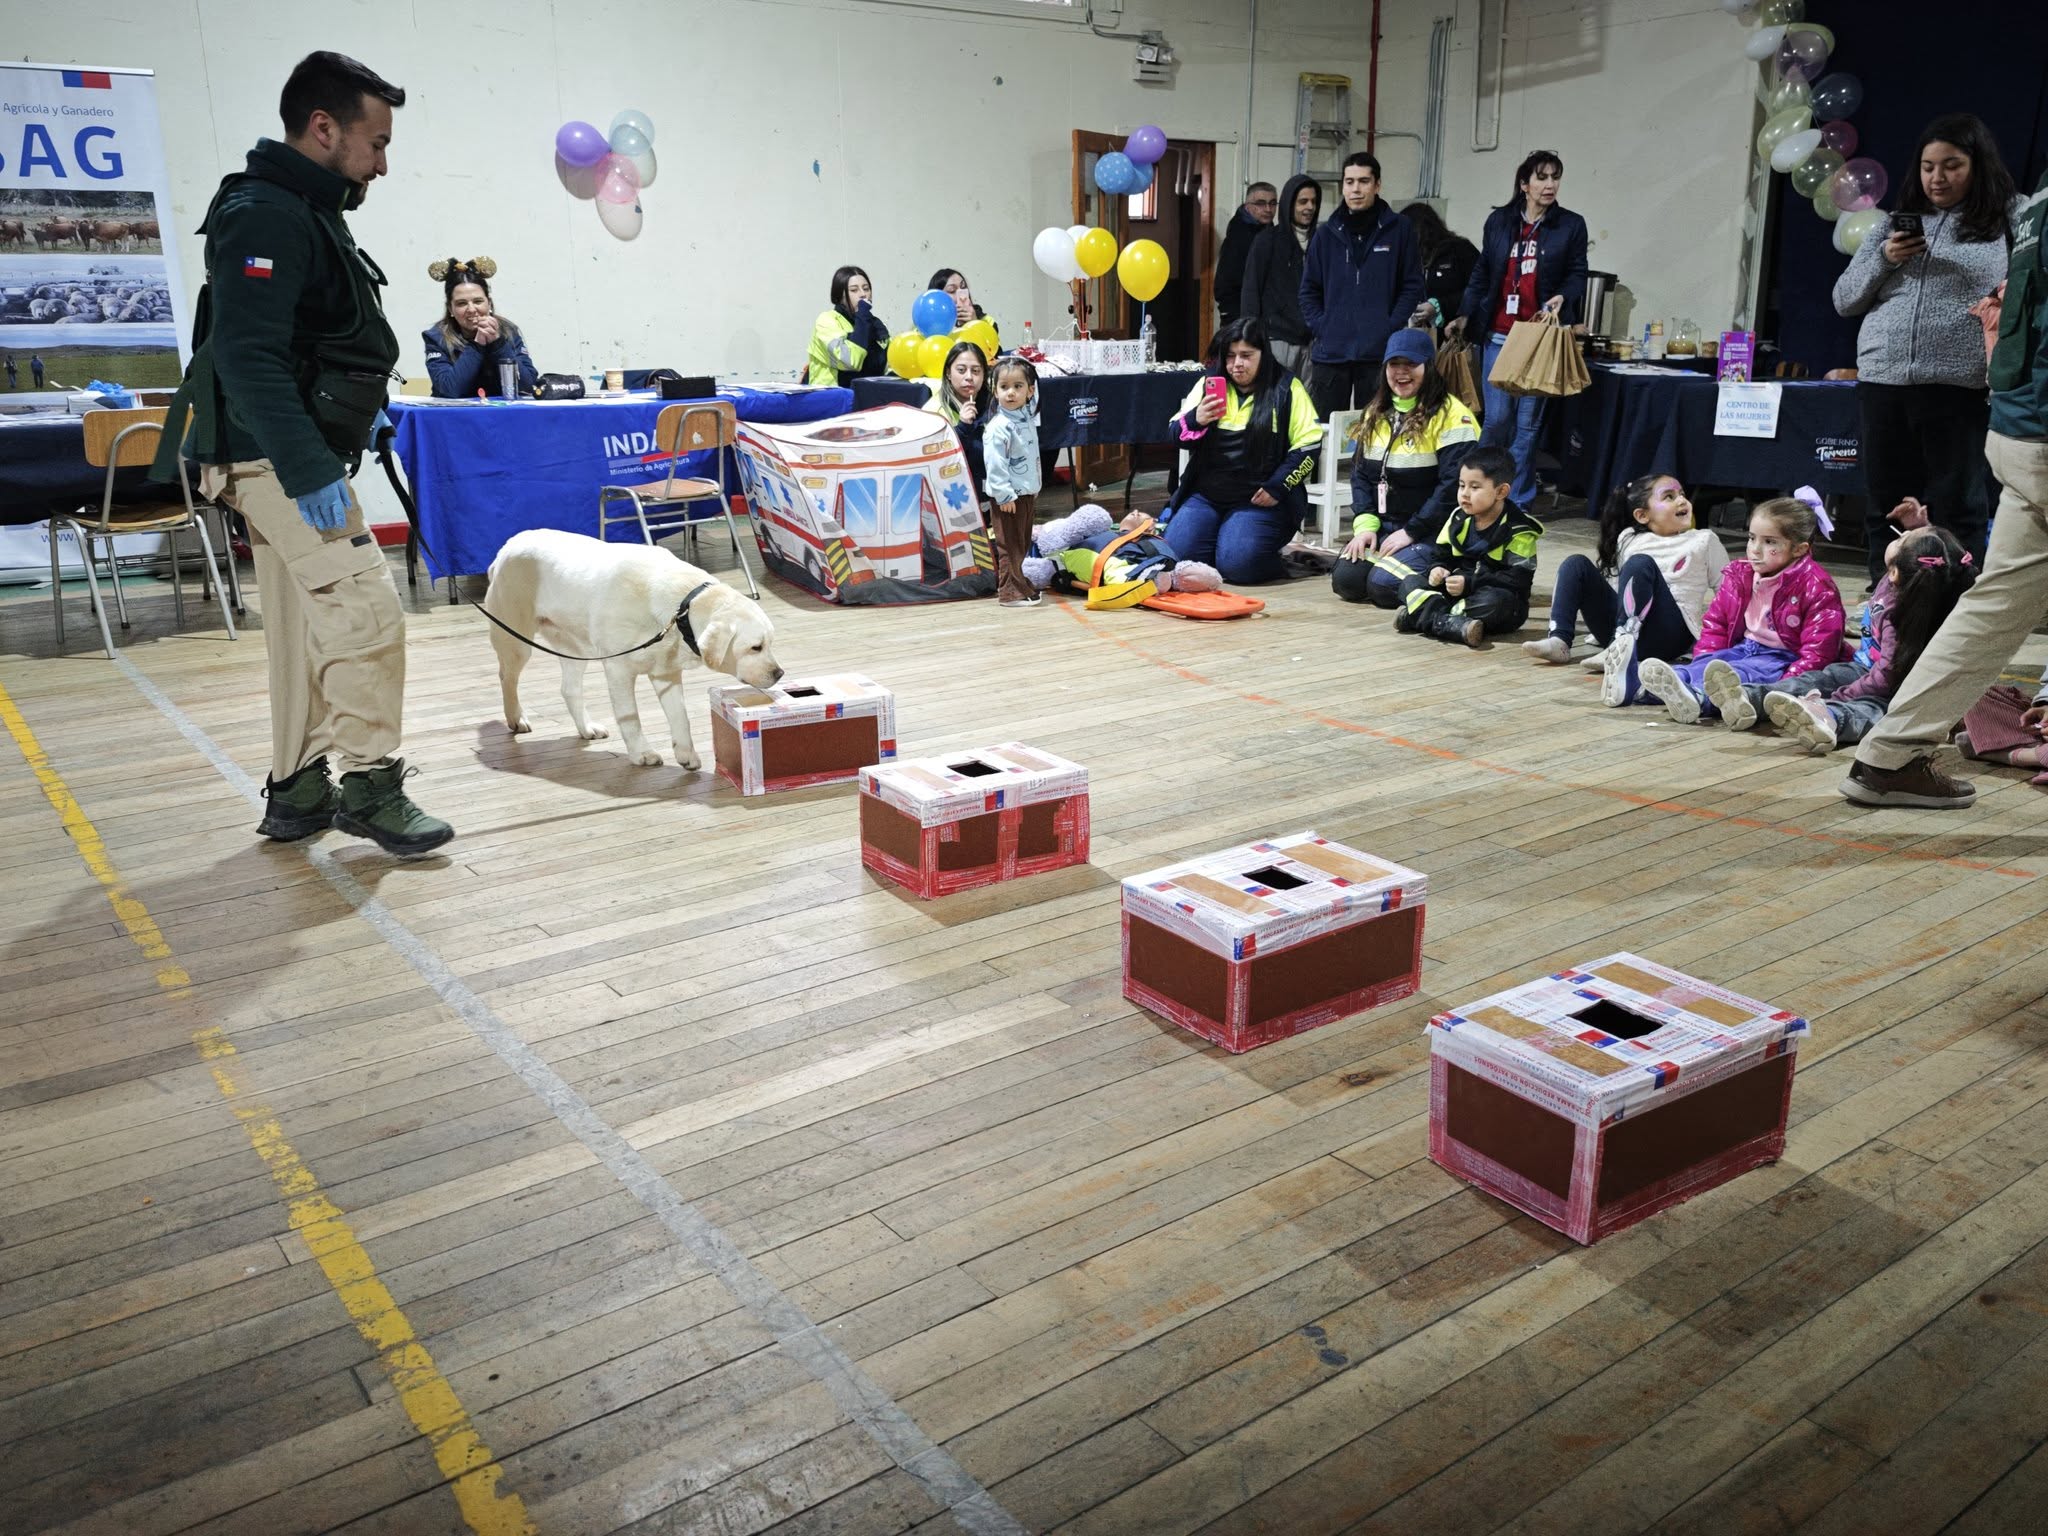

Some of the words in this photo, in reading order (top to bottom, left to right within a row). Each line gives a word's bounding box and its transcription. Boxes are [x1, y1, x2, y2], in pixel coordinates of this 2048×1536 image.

[3, 102, 49, 116] Agrícola
[52, 107, 58, 117] y
[61, 105, 114, 117] Ganadero
[0, 123, 124, 180] AG
[1726, 401, 1757, 409] CENTRO
[1759, 401, 1770, 409] DE
[1736, 412, 1771, 420] MUJERES
[1815, 438, 1858, 446] GOBIERNO
[610, 465, 643, 476] Ministerio
[653, 458, 690, 471] Agrictura
[1519, 1077, 1554, 1100] REDUCCIÓN
